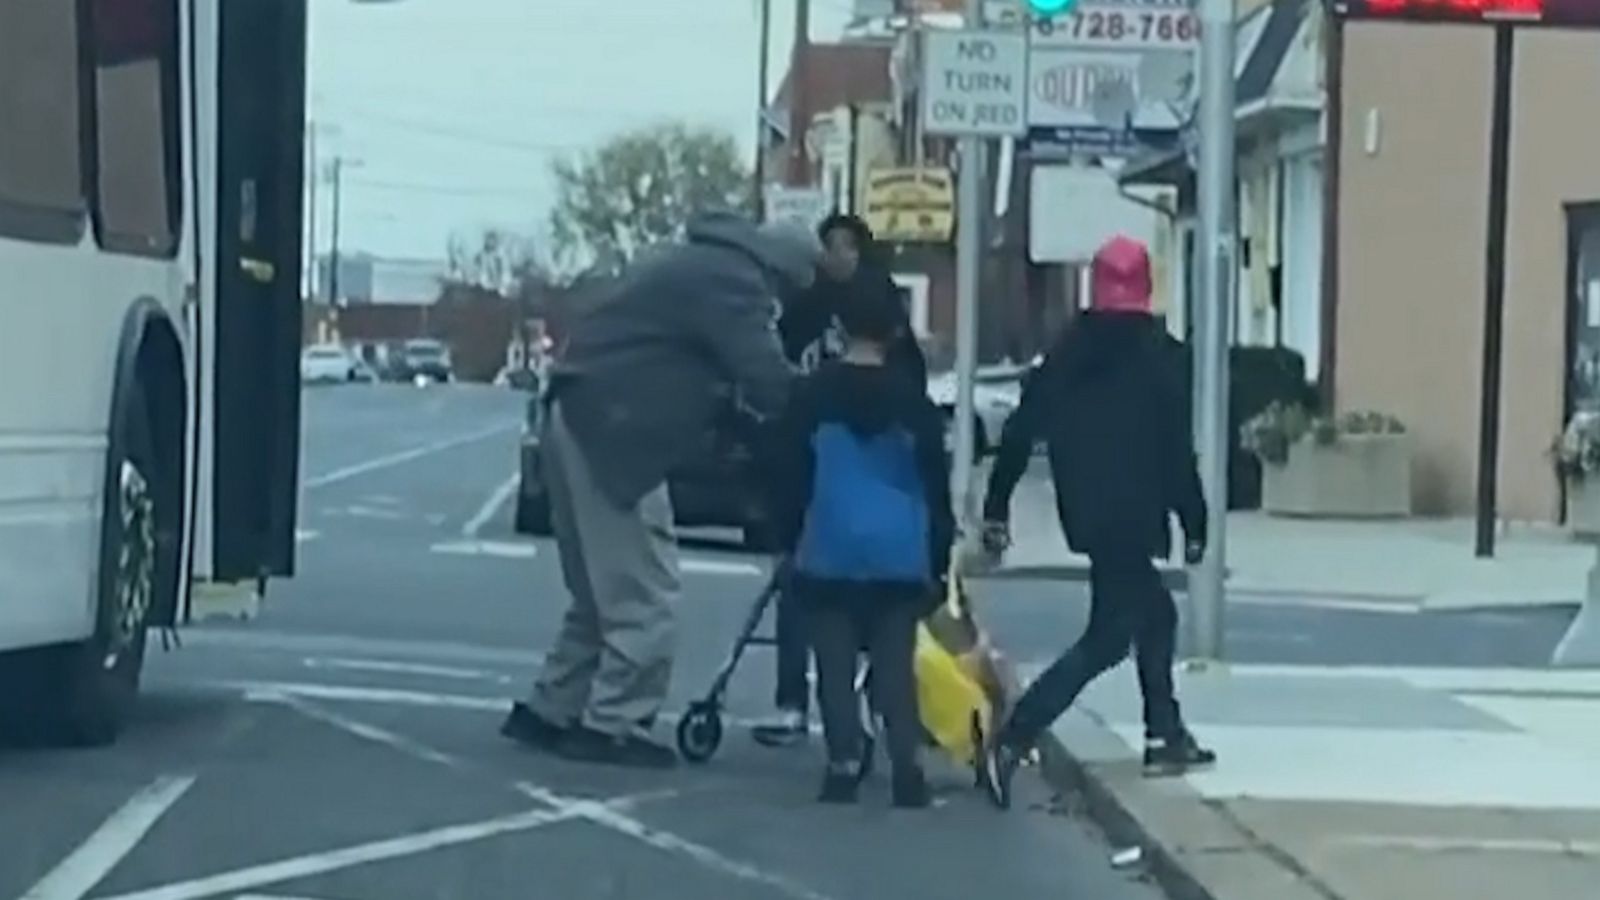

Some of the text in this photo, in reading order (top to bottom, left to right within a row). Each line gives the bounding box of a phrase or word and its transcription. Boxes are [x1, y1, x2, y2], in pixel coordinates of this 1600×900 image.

[958, 41, 997, 61] NO
[944, 70, 1012, 94] TURN
[932, 101, 1018, 126] ON RED
